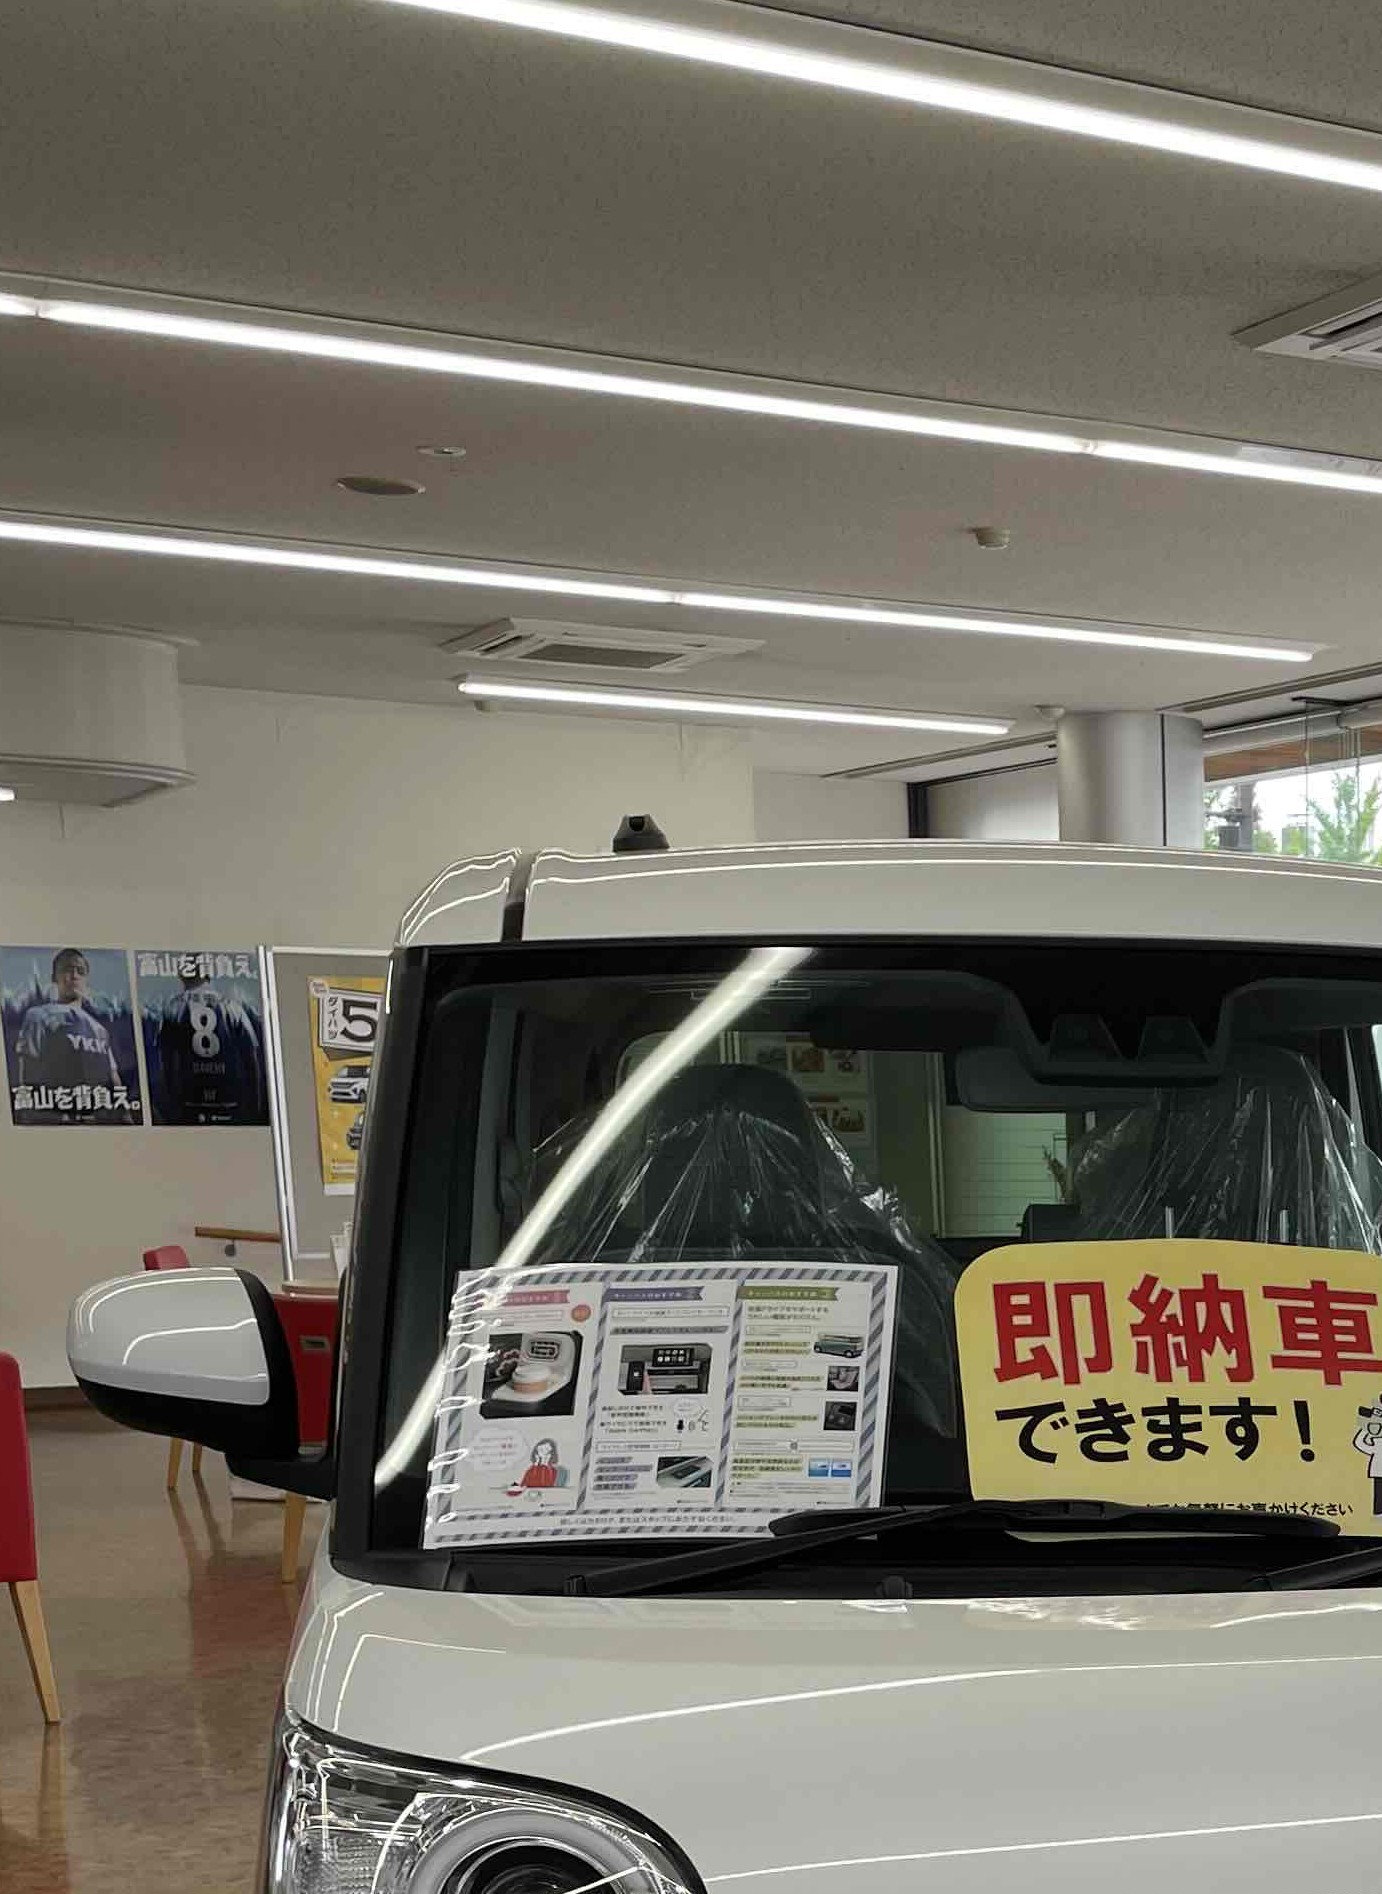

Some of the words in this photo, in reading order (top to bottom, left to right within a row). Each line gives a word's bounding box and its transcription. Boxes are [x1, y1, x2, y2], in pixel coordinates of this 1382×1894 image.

[190, 1002, 221, 1058] 8
[995, 1396, 1315, 1465] できます!
